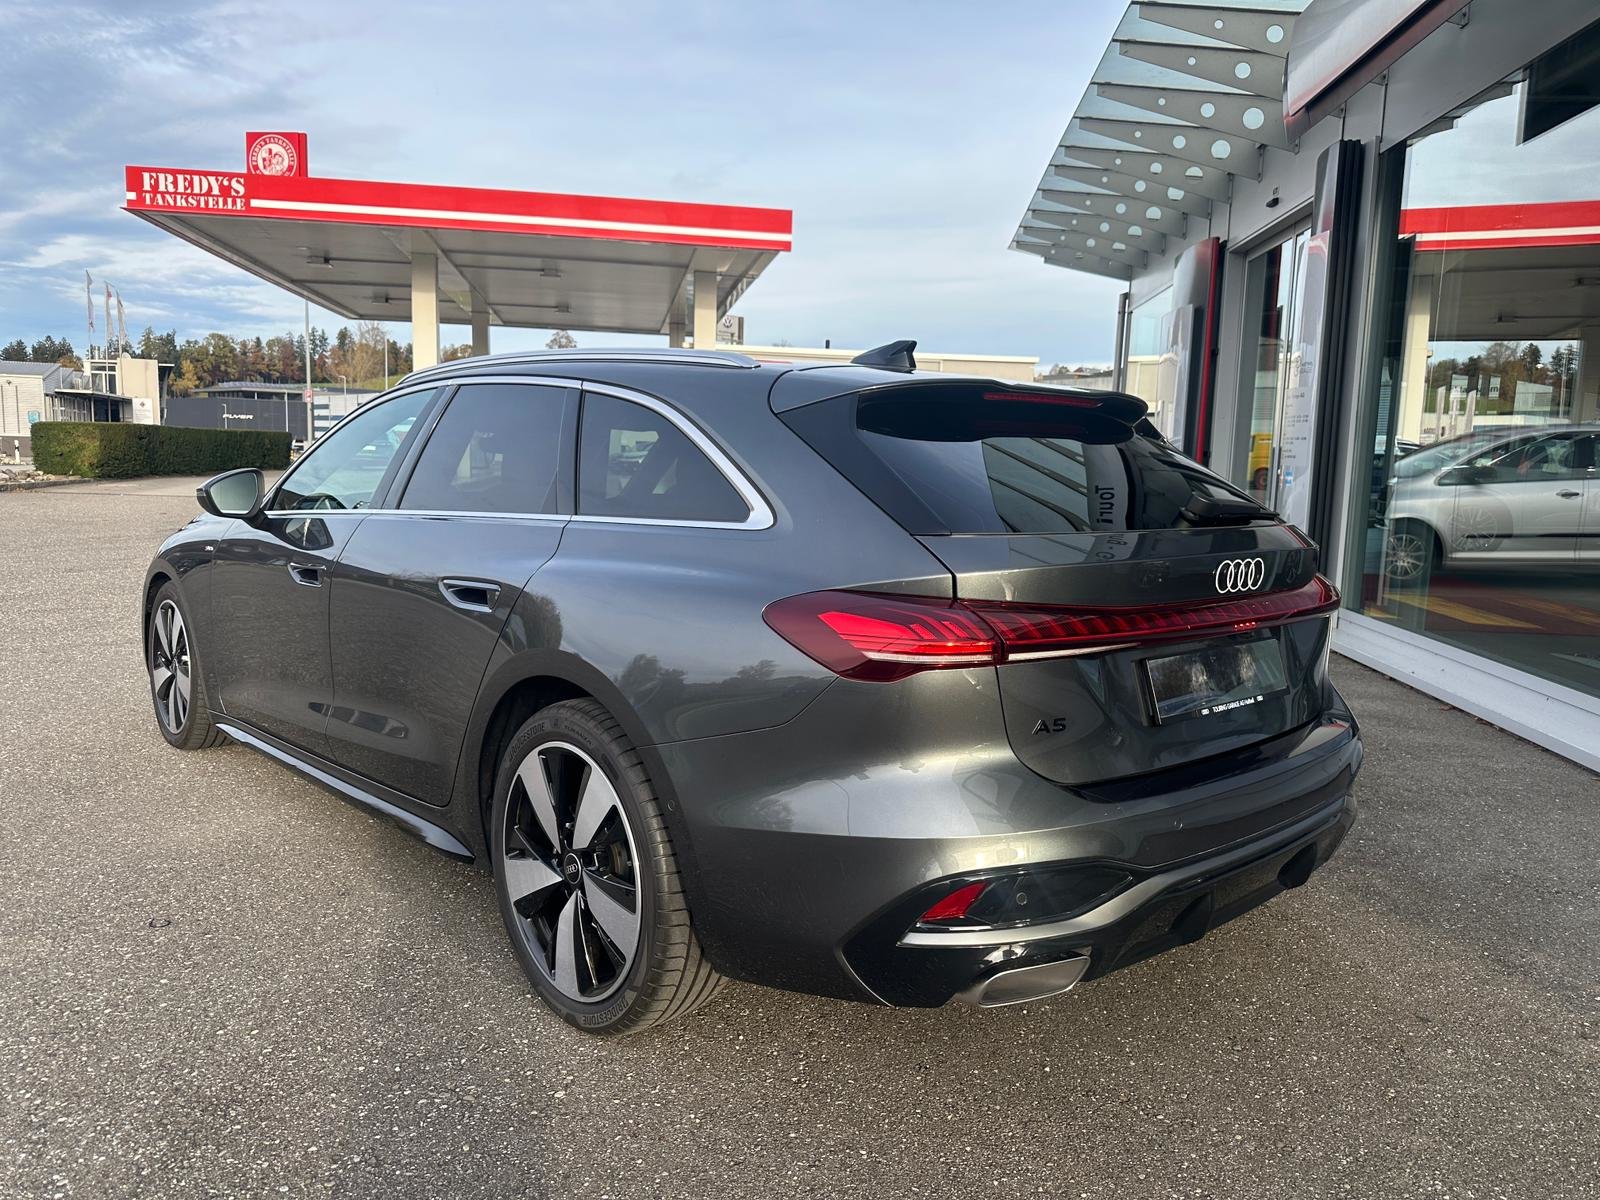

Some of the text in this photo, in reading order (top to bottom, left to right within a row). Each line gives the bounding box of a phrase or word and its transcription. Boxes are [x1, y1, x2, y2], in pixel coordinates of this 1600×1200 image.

[142, 172, 245, 197] FREDY'S
[143, 193, 245, 210] TANKSTELLE
[1032, 717, 1066, 735] A5
